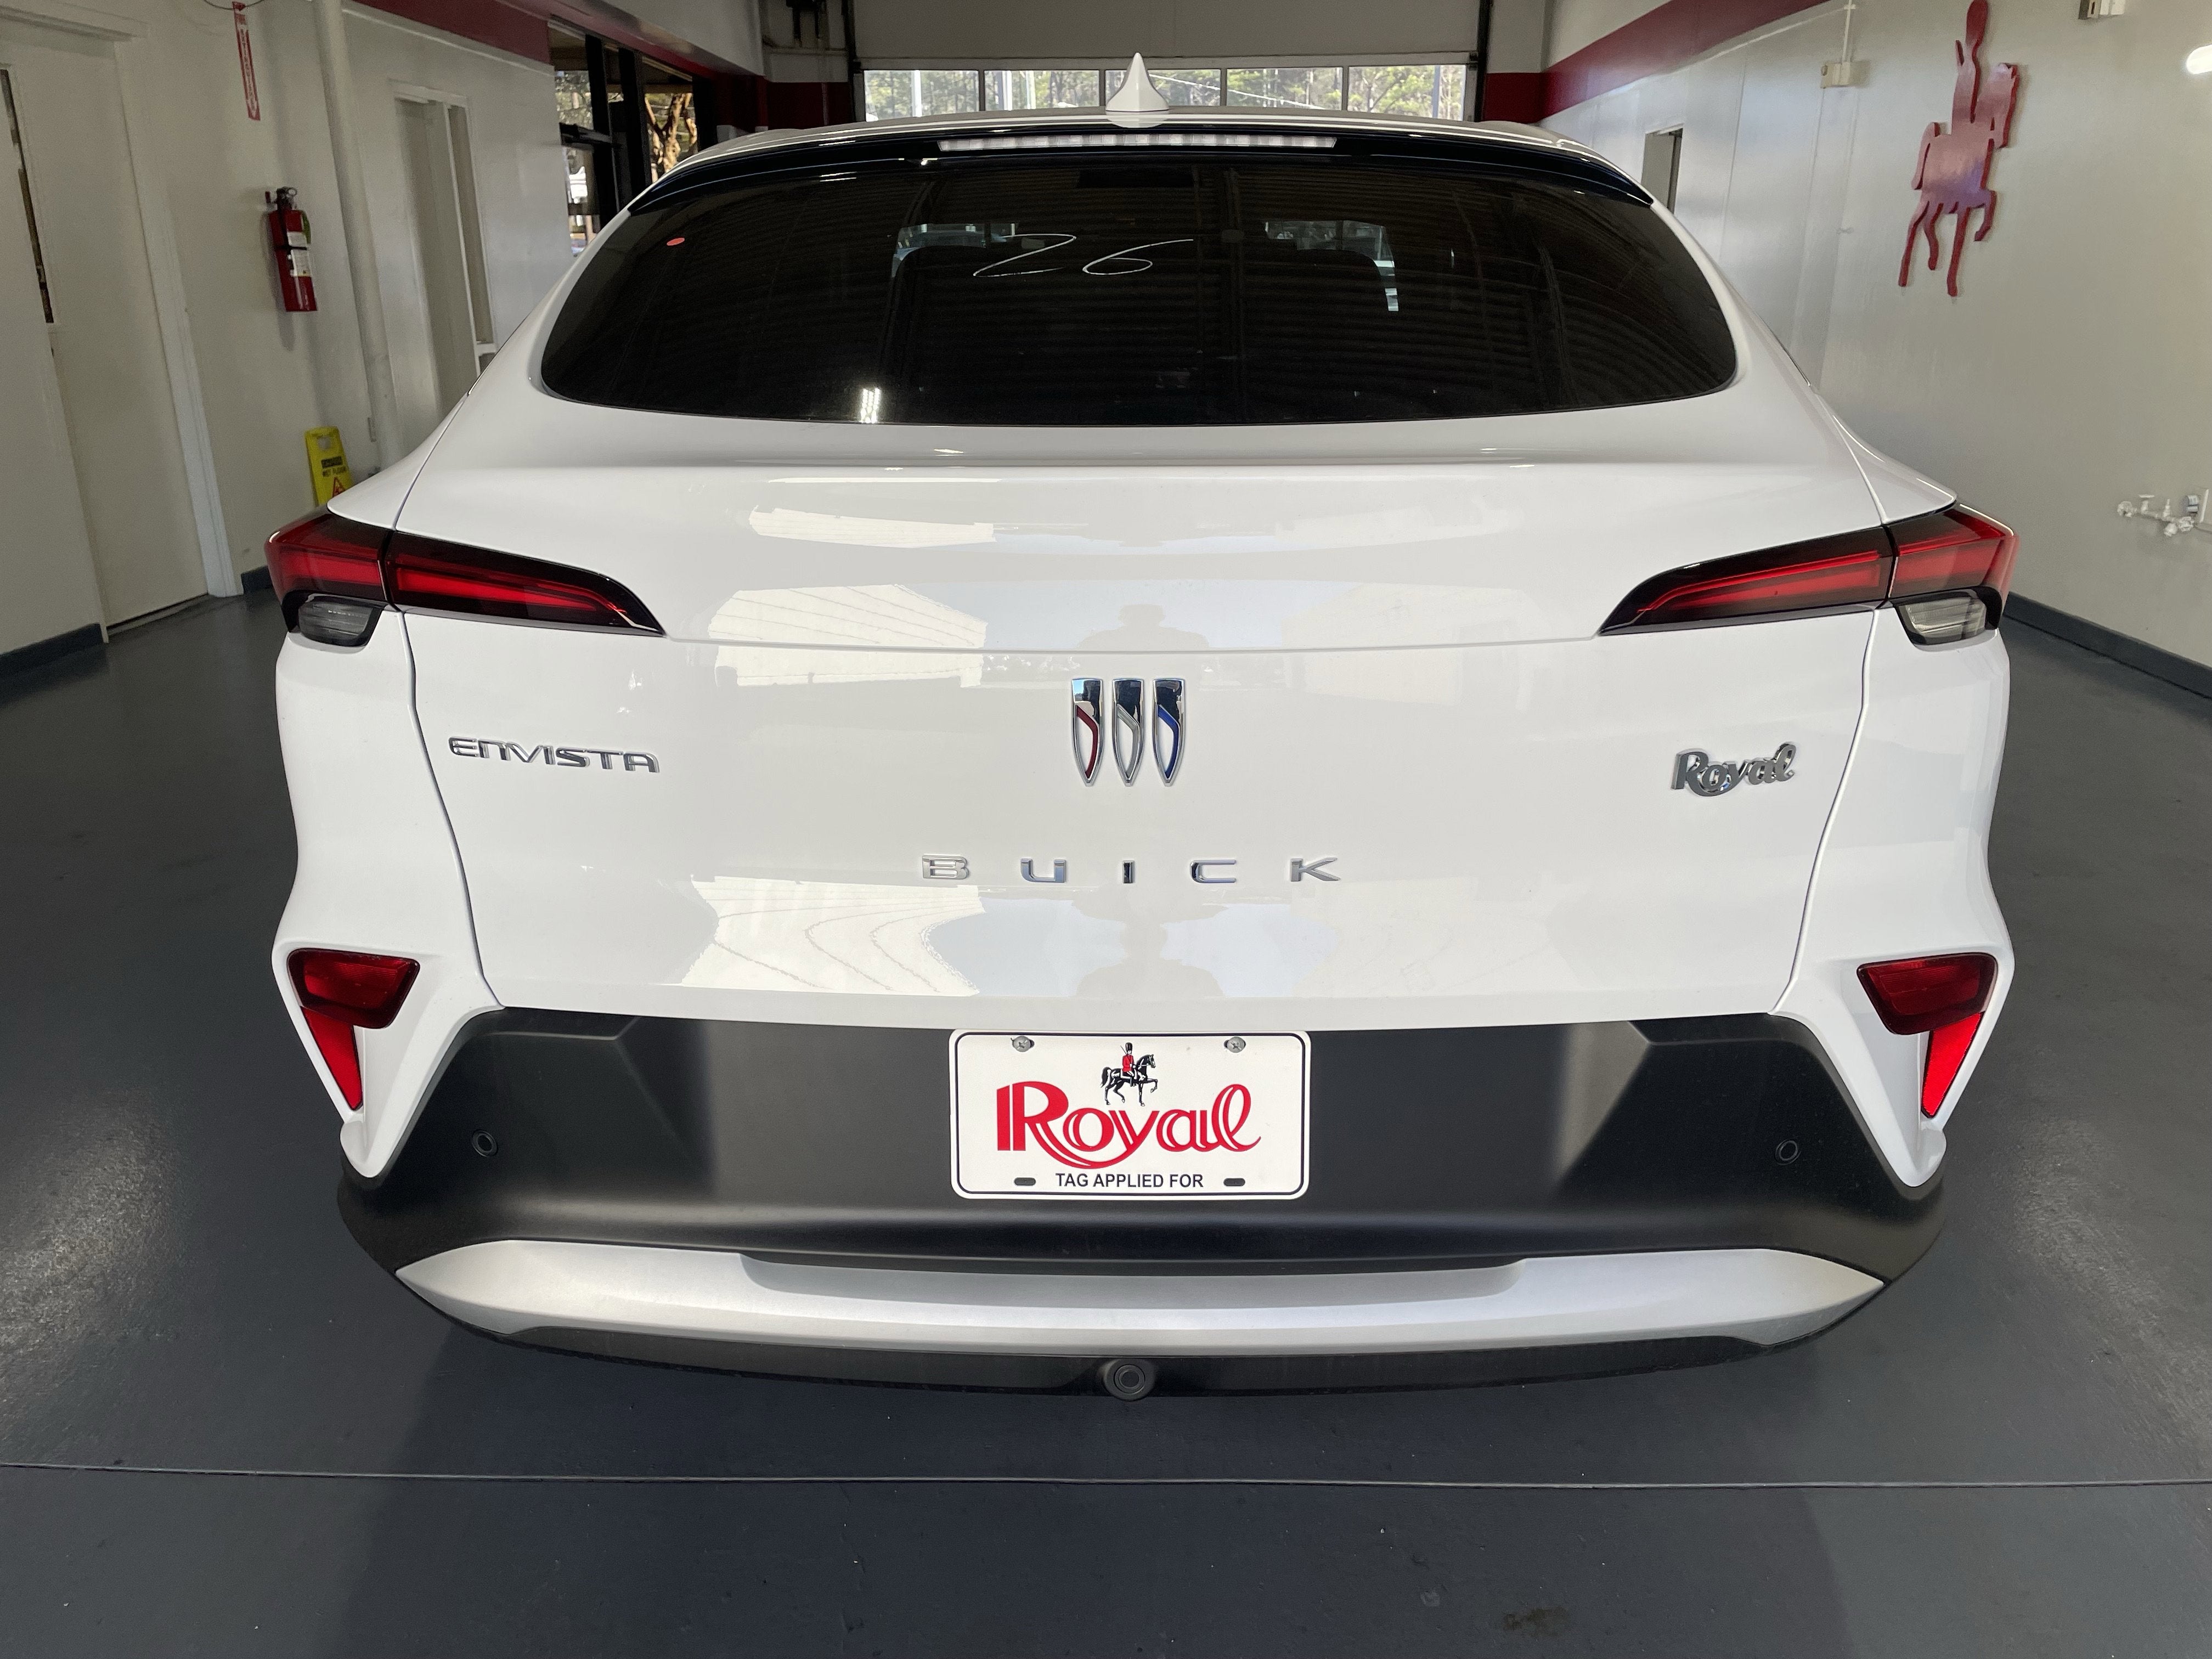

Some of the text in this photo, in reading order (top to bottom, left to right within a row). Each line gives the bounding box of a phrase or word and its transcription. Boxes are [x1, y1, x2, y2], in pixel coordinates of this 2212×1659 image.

[973, 233, 1194, 277] 26
[448, 736, 659, 773] ENVISTA
[1671, 741, 1796, 797] Royal
[922, 854, 1341, 884] BUICK
[996, 1081, 1261, 1169] Royal
[1056, 1173, 1204, 1188] TAG APPLIED FOR
